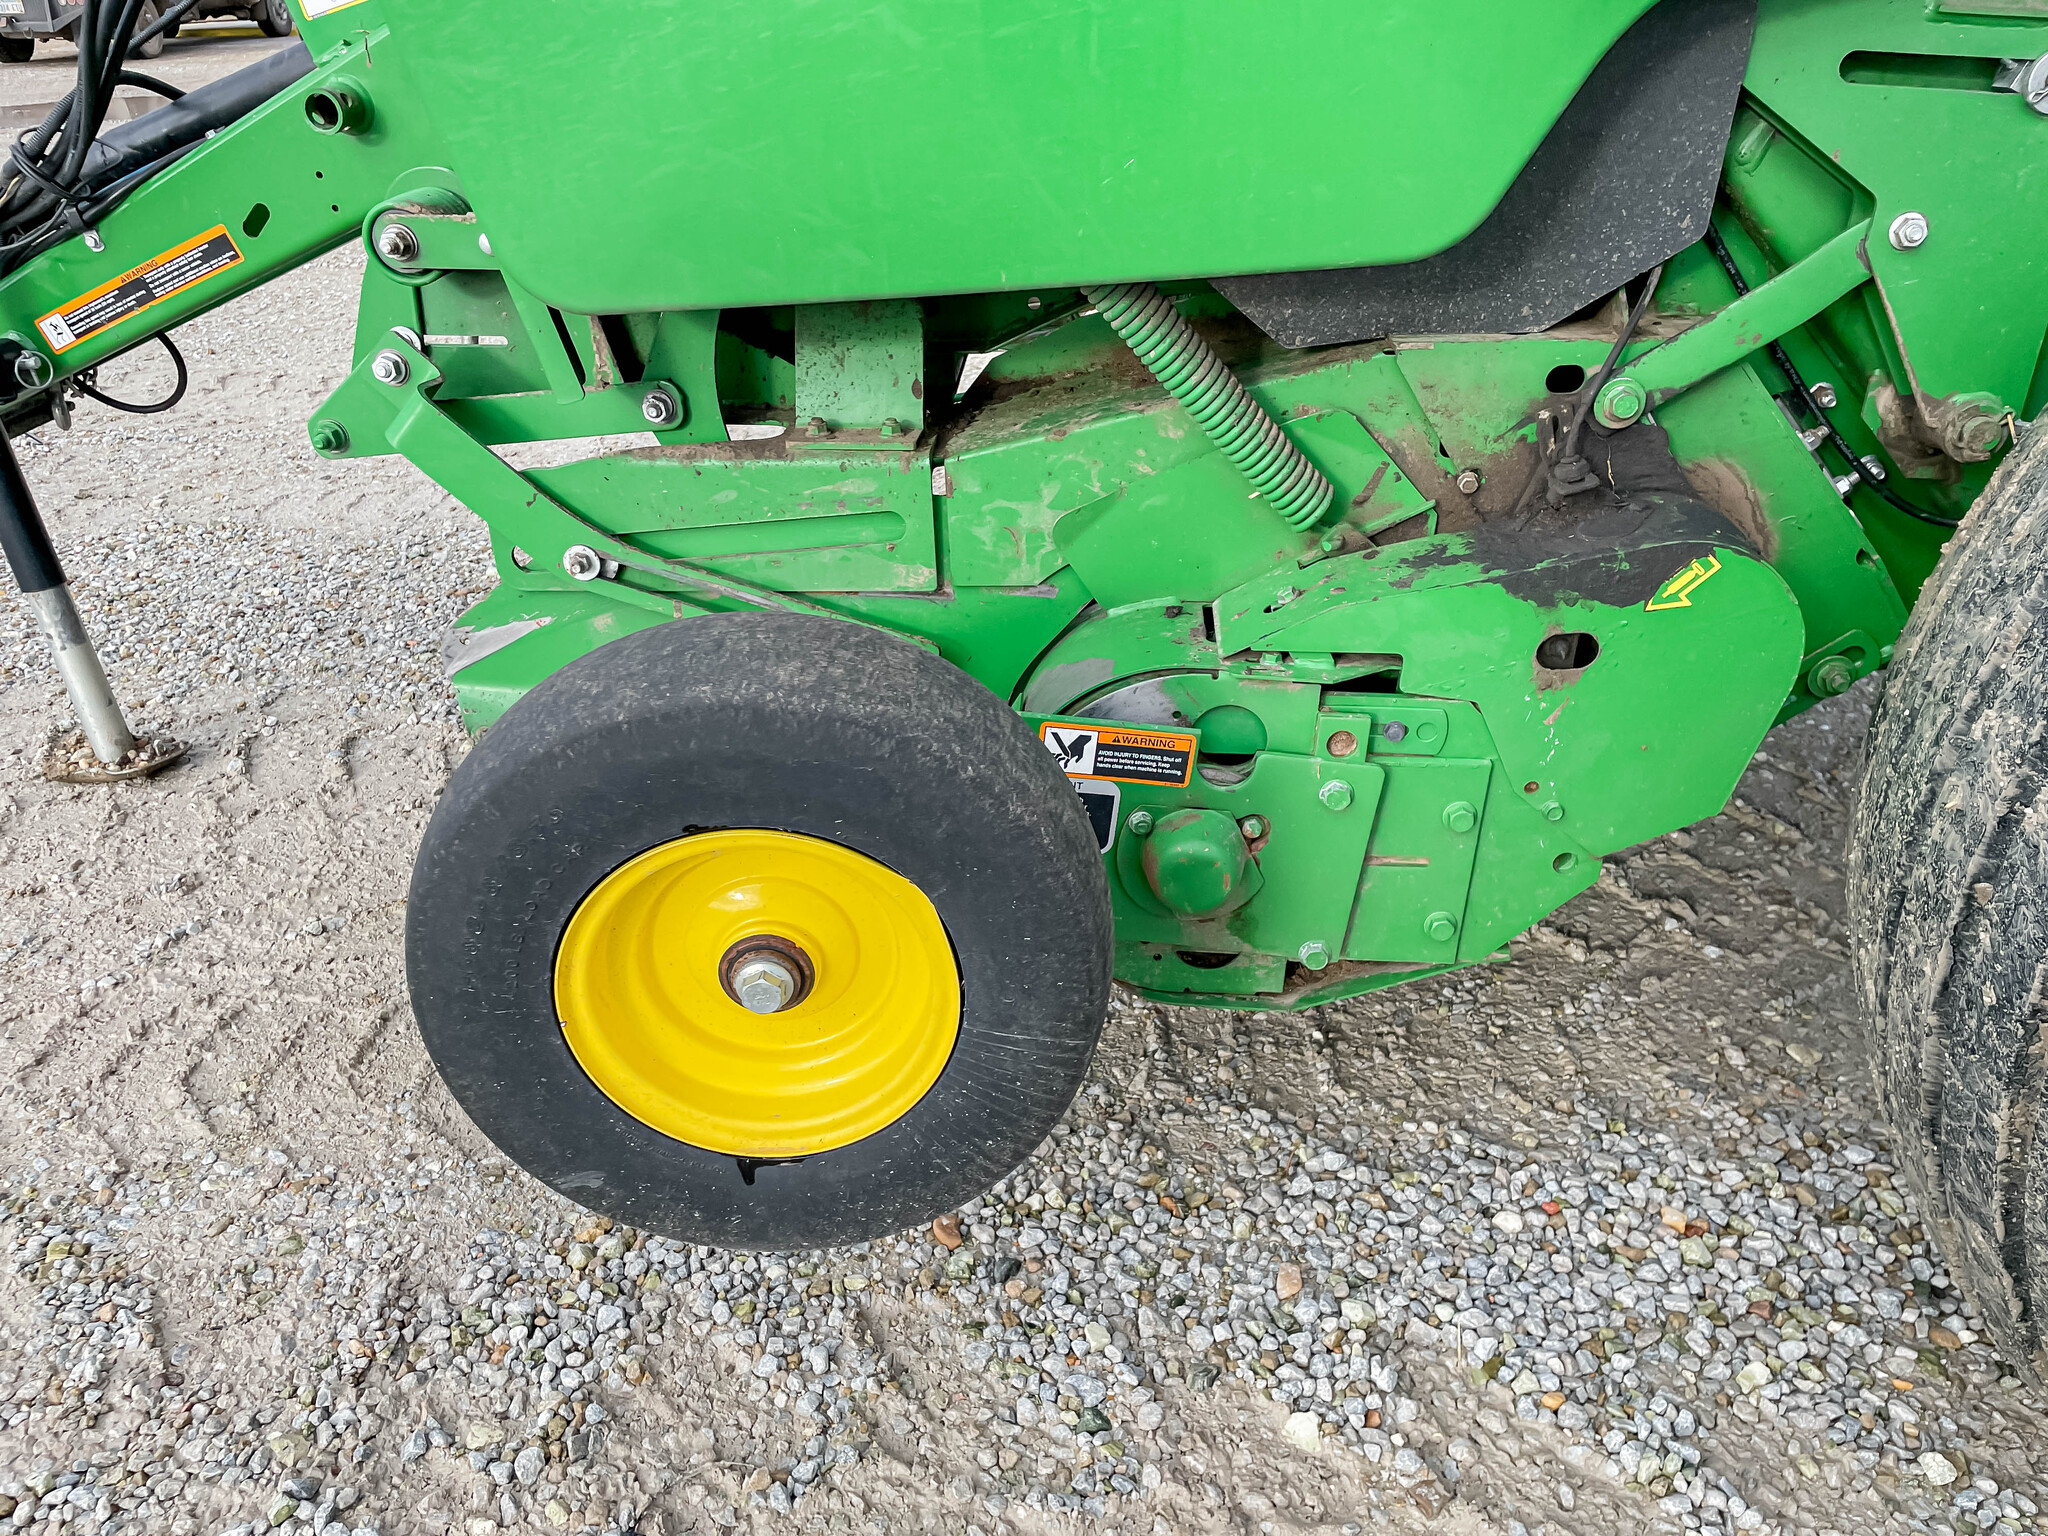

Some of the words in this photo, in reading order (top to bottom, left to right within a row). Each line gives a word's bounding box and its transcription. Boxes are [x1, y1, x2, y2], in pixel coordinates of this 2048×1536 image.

[124, 259, 158, 281] WARNING
[1122, 736, 1176, 749] WARNING
[1134, 759, 1157, 767] servicing.
[1162, 768, 1182, 777] running.
